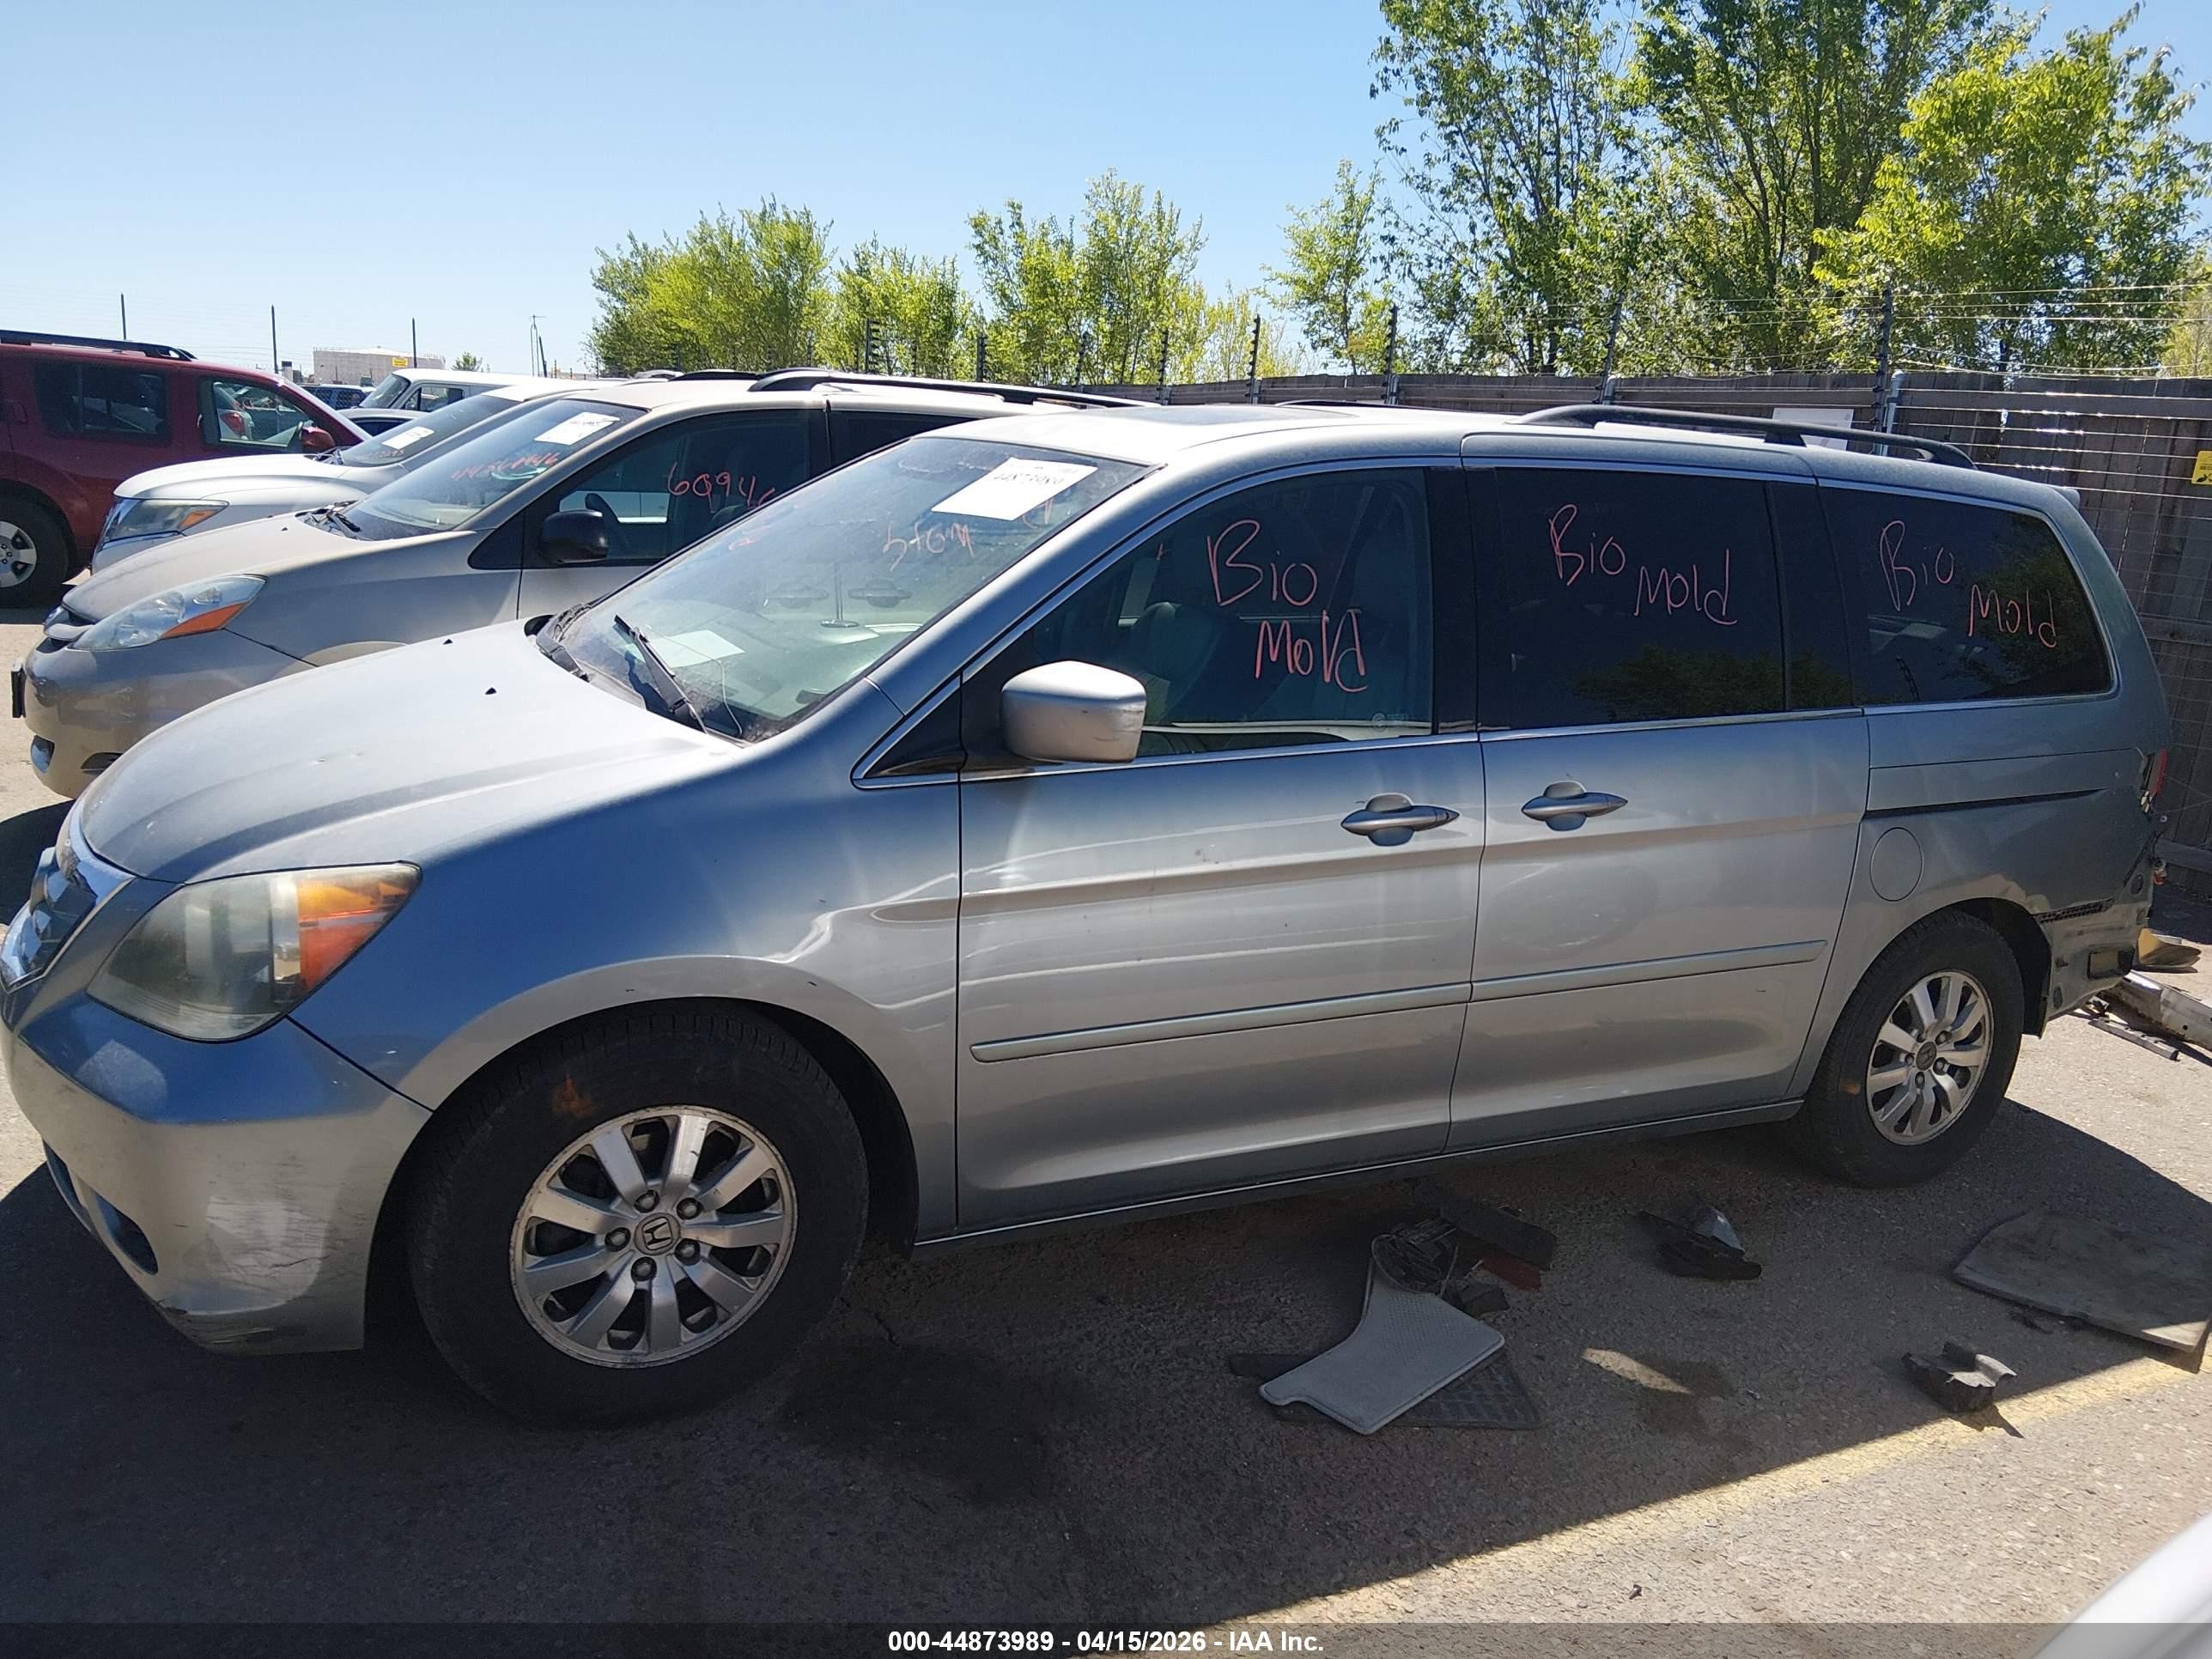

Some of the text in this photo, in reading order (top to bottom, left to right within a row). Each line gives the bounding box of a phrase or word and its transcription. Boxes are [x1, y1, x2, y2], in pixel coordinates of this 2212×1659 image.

[1206, 519, 1318, 605] Bio
[1547, 503, 1738, 625] Bio Mold
[1880, 520, 2057, 648] Bio Mold
[1255, 609, 1368, 692] Mold
